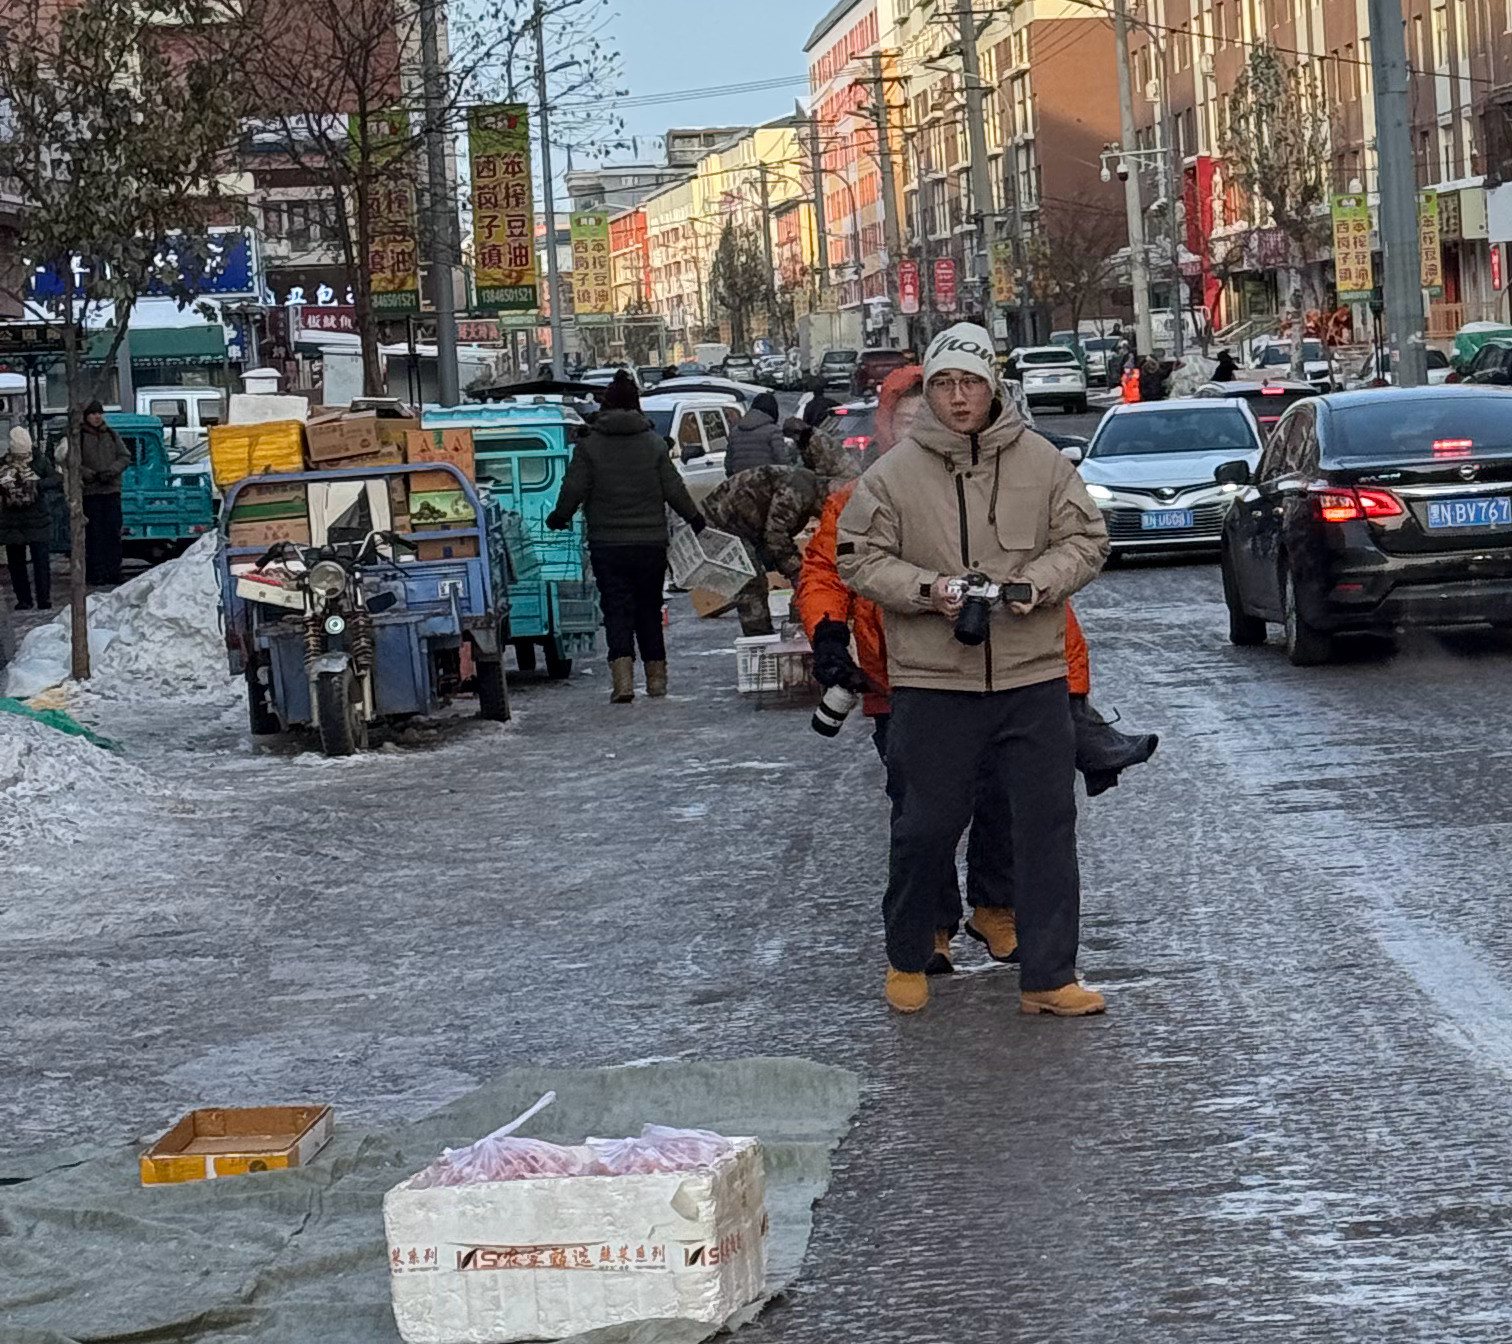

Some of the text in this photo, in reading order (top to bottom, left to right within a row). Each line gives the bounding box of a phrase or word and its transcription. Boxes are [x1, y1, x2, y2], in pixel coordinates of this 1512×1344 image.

[475, 154, 503, 269] 西岗子镇
[502, 153, 530, 268] 笨榨豆油
[481, 289, 533, 304] 13846501521
